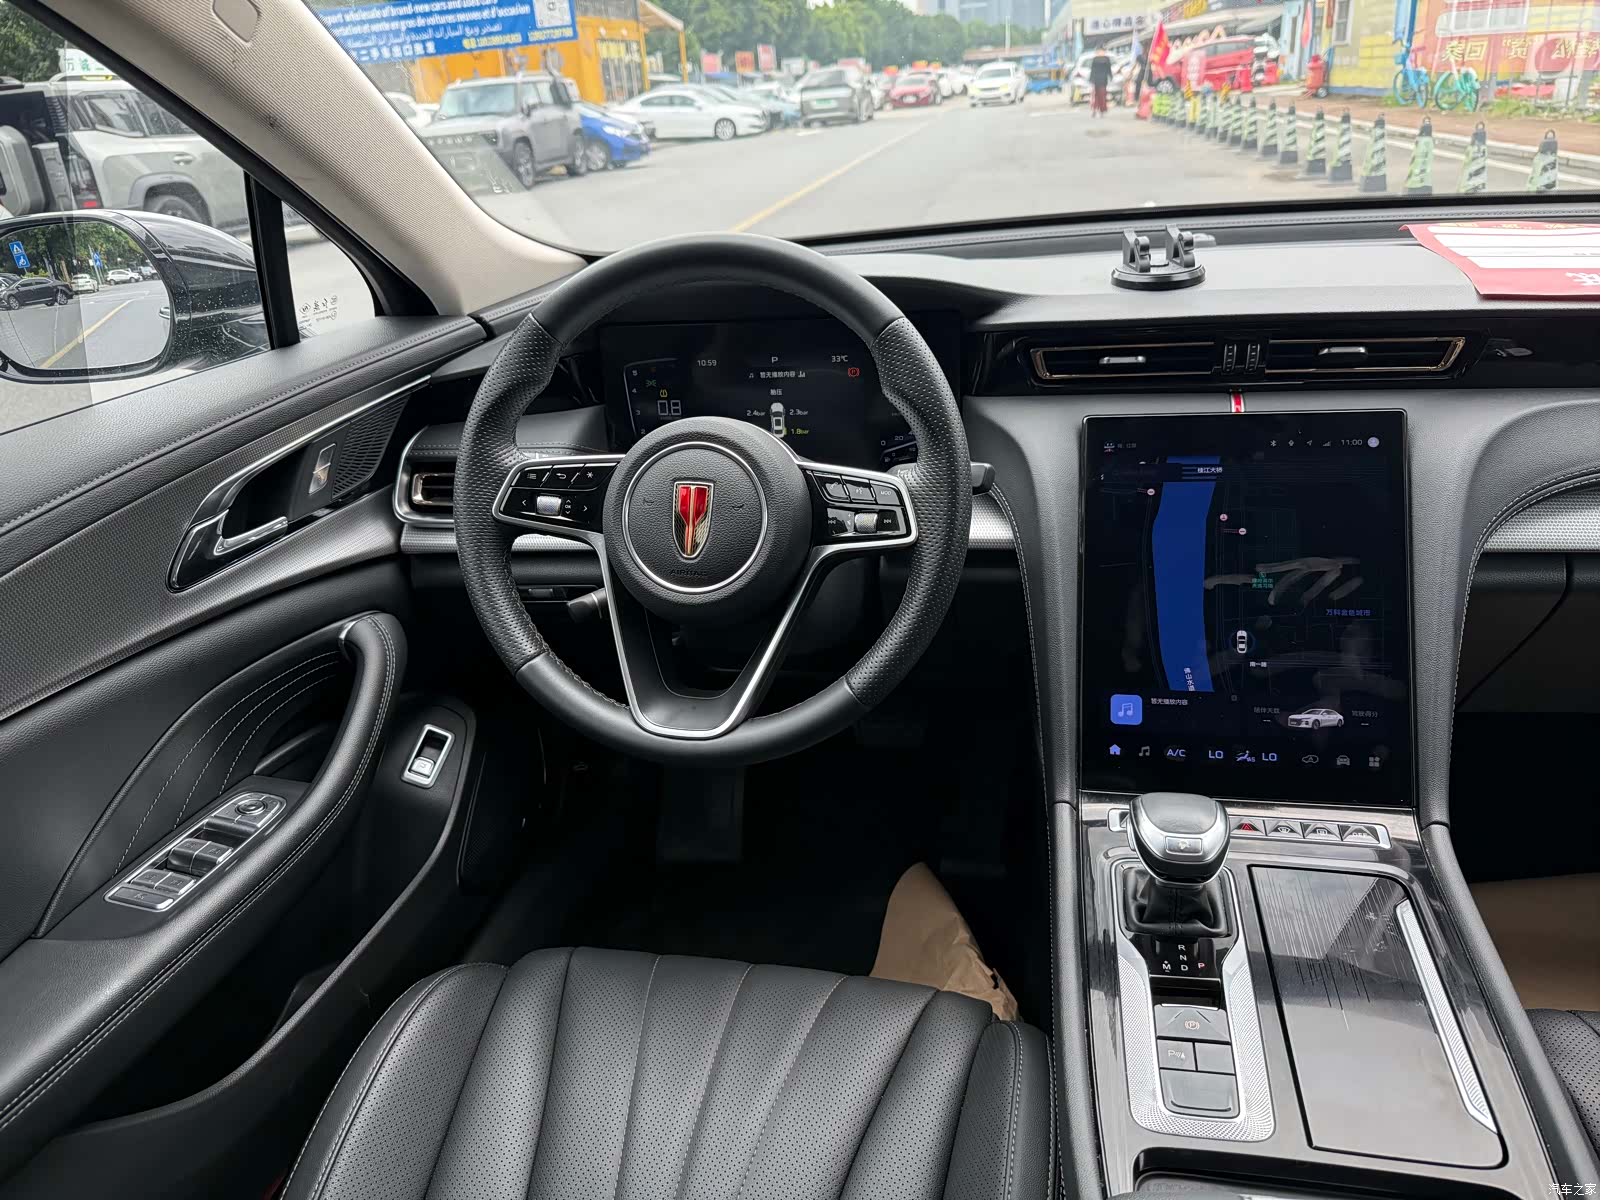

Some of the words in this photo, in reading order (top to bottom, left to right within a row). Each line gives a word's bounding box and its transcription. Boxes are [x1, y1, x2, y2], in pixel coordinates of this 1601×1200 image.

[771, 356, 779, 364] P
[657, 400, 682, 416] 0.8
[1166, 748, 1187, 758] A/C
[1208, 750, 1224, 759] LO
[1261, 752, 1278, 762] LO
